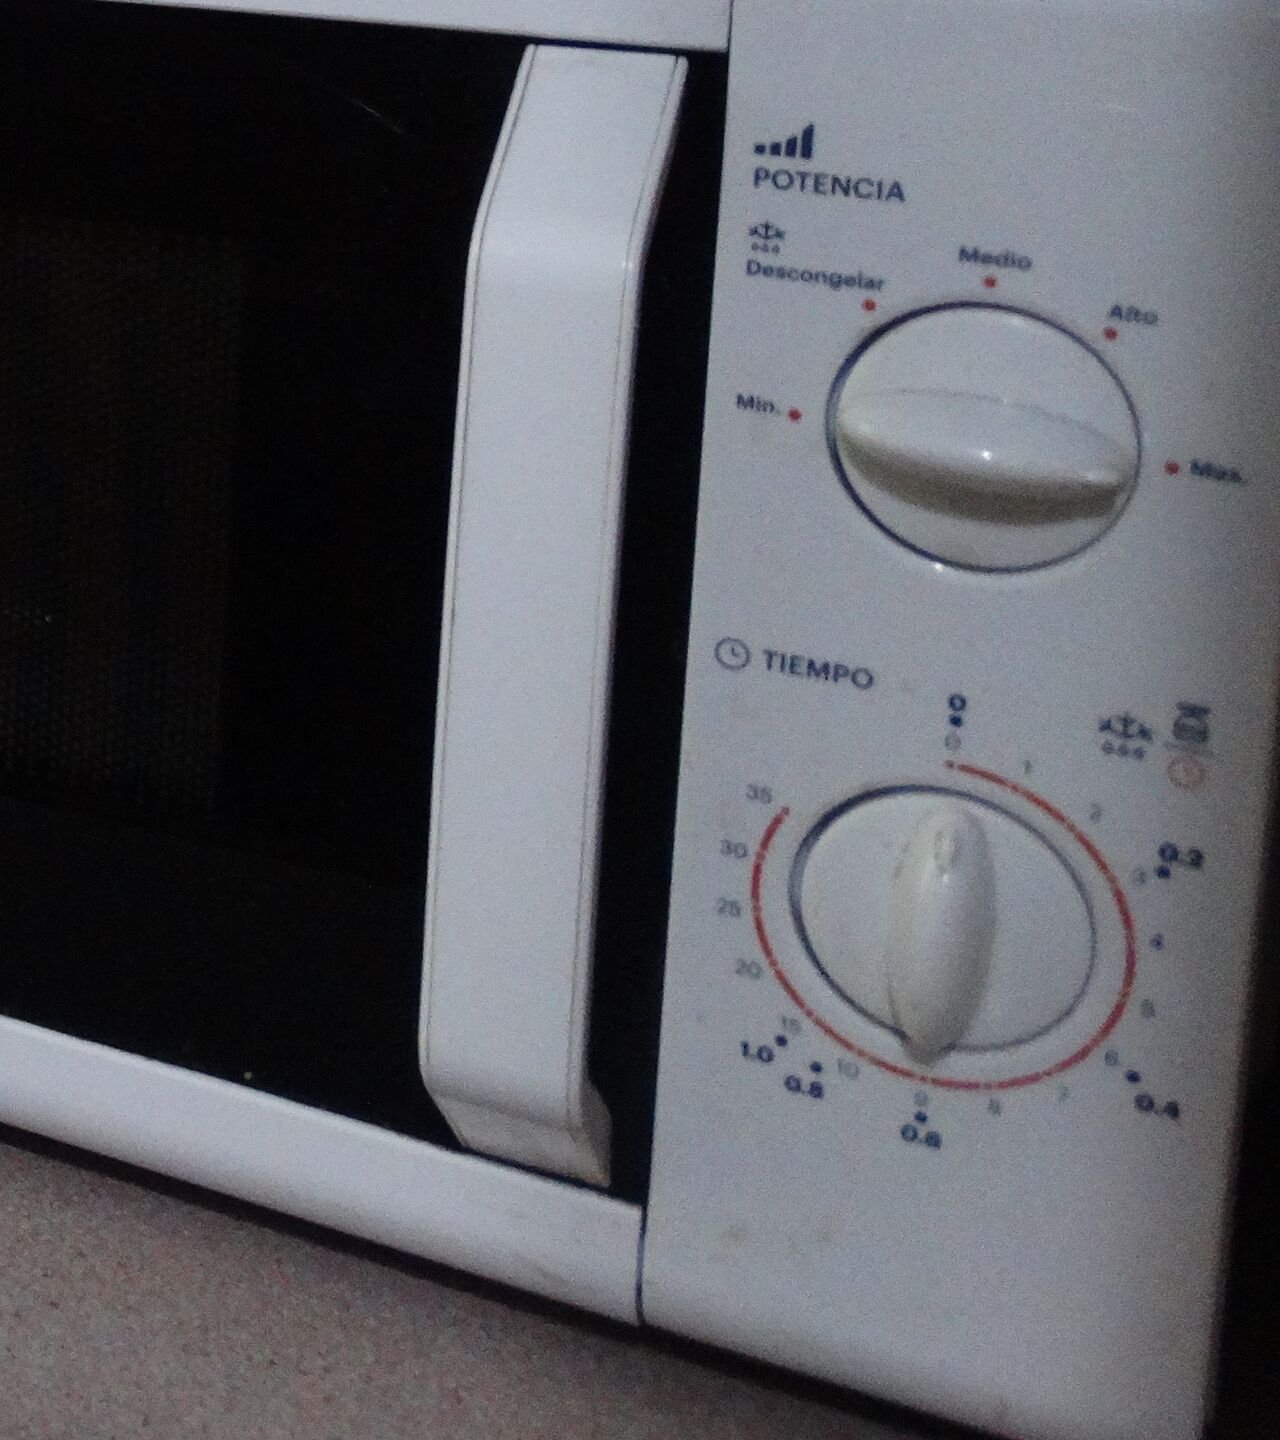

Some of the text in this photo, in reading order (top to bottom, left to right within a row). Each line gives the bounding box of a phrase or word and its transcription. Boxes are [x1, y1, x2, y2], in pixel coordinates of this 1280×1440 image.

[753, 166, 907, 203] POTENCIA
[959, 244, 1033, 272] Medio
[744, 259, 886, 293] Descongelar
[761, 649, 874, 690] TIEMPO
